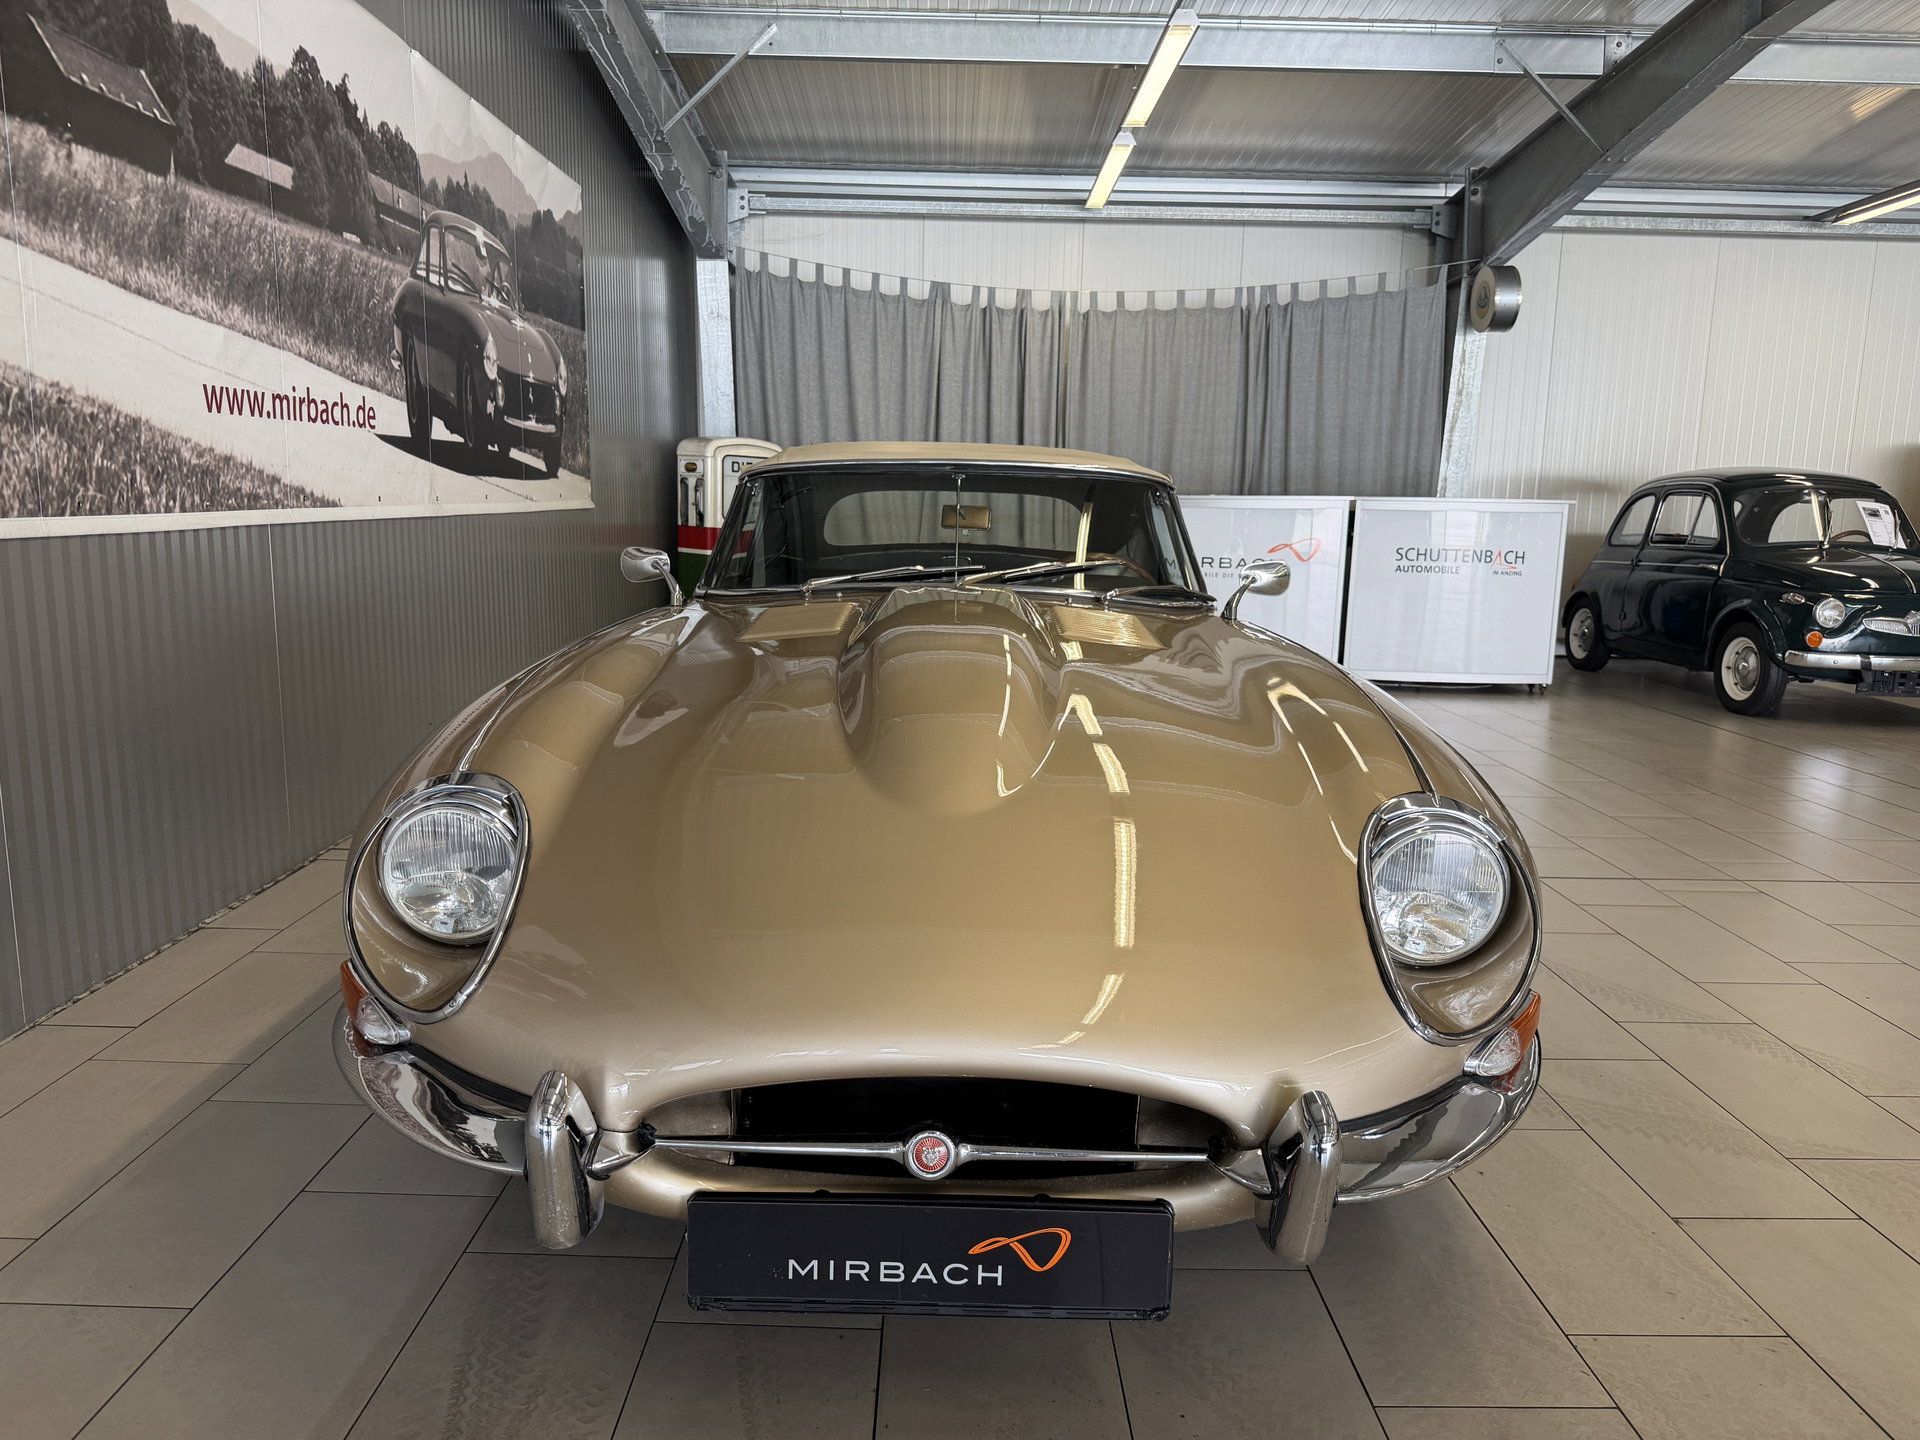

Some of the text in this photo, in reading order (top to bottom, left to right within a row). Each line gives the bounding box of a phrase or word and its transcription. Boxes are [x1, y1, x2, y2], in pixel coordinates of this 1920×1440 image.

[202, 383, 376, 430] www.mirbach.de
[1395, 547, 1526, 566] SCHUTTENBACH
[1395, 564, 1461, 575] AUTOMOBILE
[788, 1258, 1003, 1287] MIRBACH
